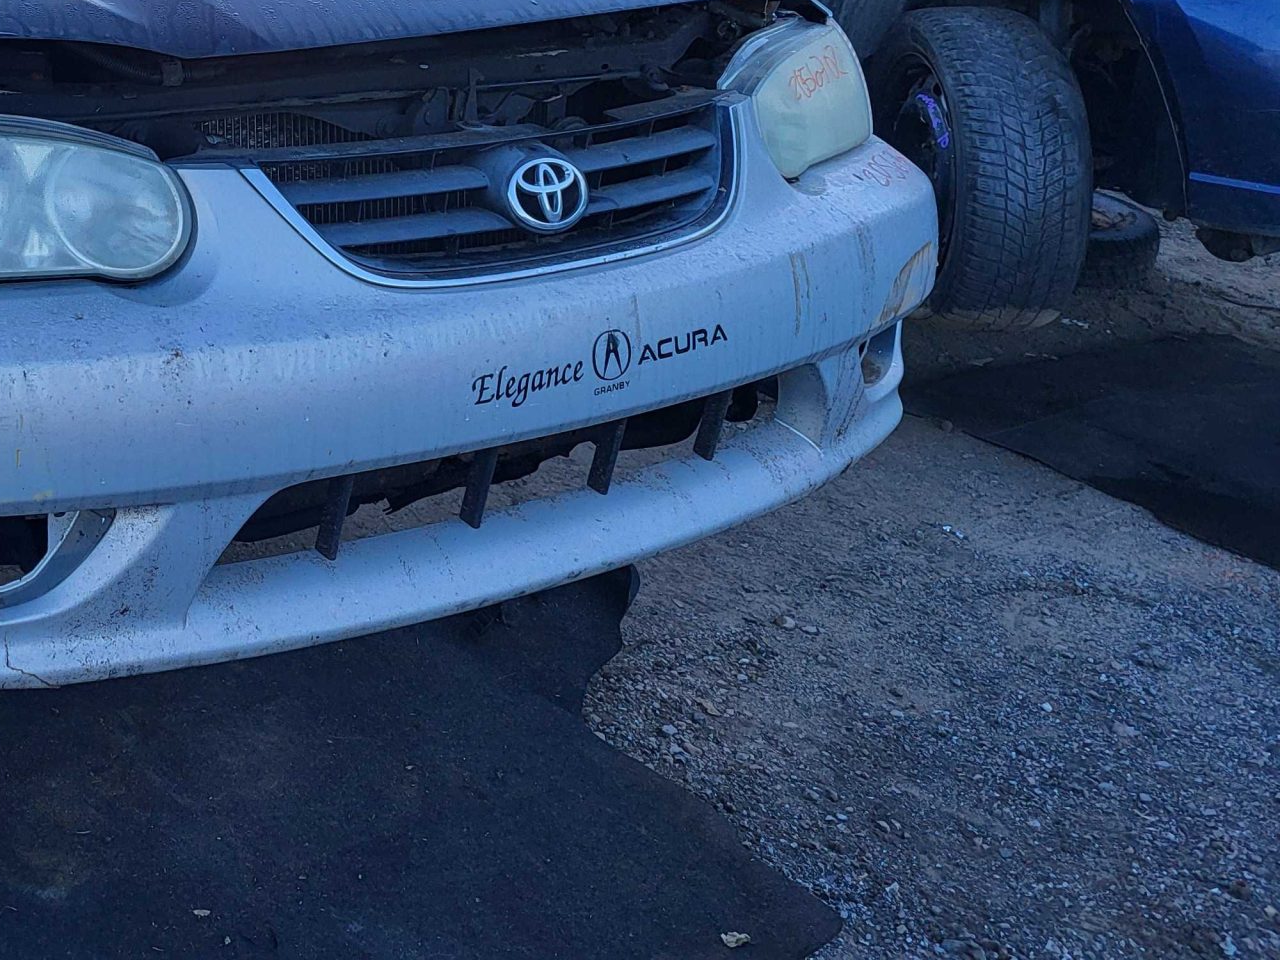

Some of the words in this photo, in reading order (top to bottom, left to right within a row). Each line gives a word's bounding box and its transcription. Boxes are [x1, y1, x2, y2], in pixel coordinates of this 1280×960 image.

[471, 360, 585, 408] Elegance
[637, 323, 729, 366] ACURA
[593, 379, 631, 397] GRANBY
